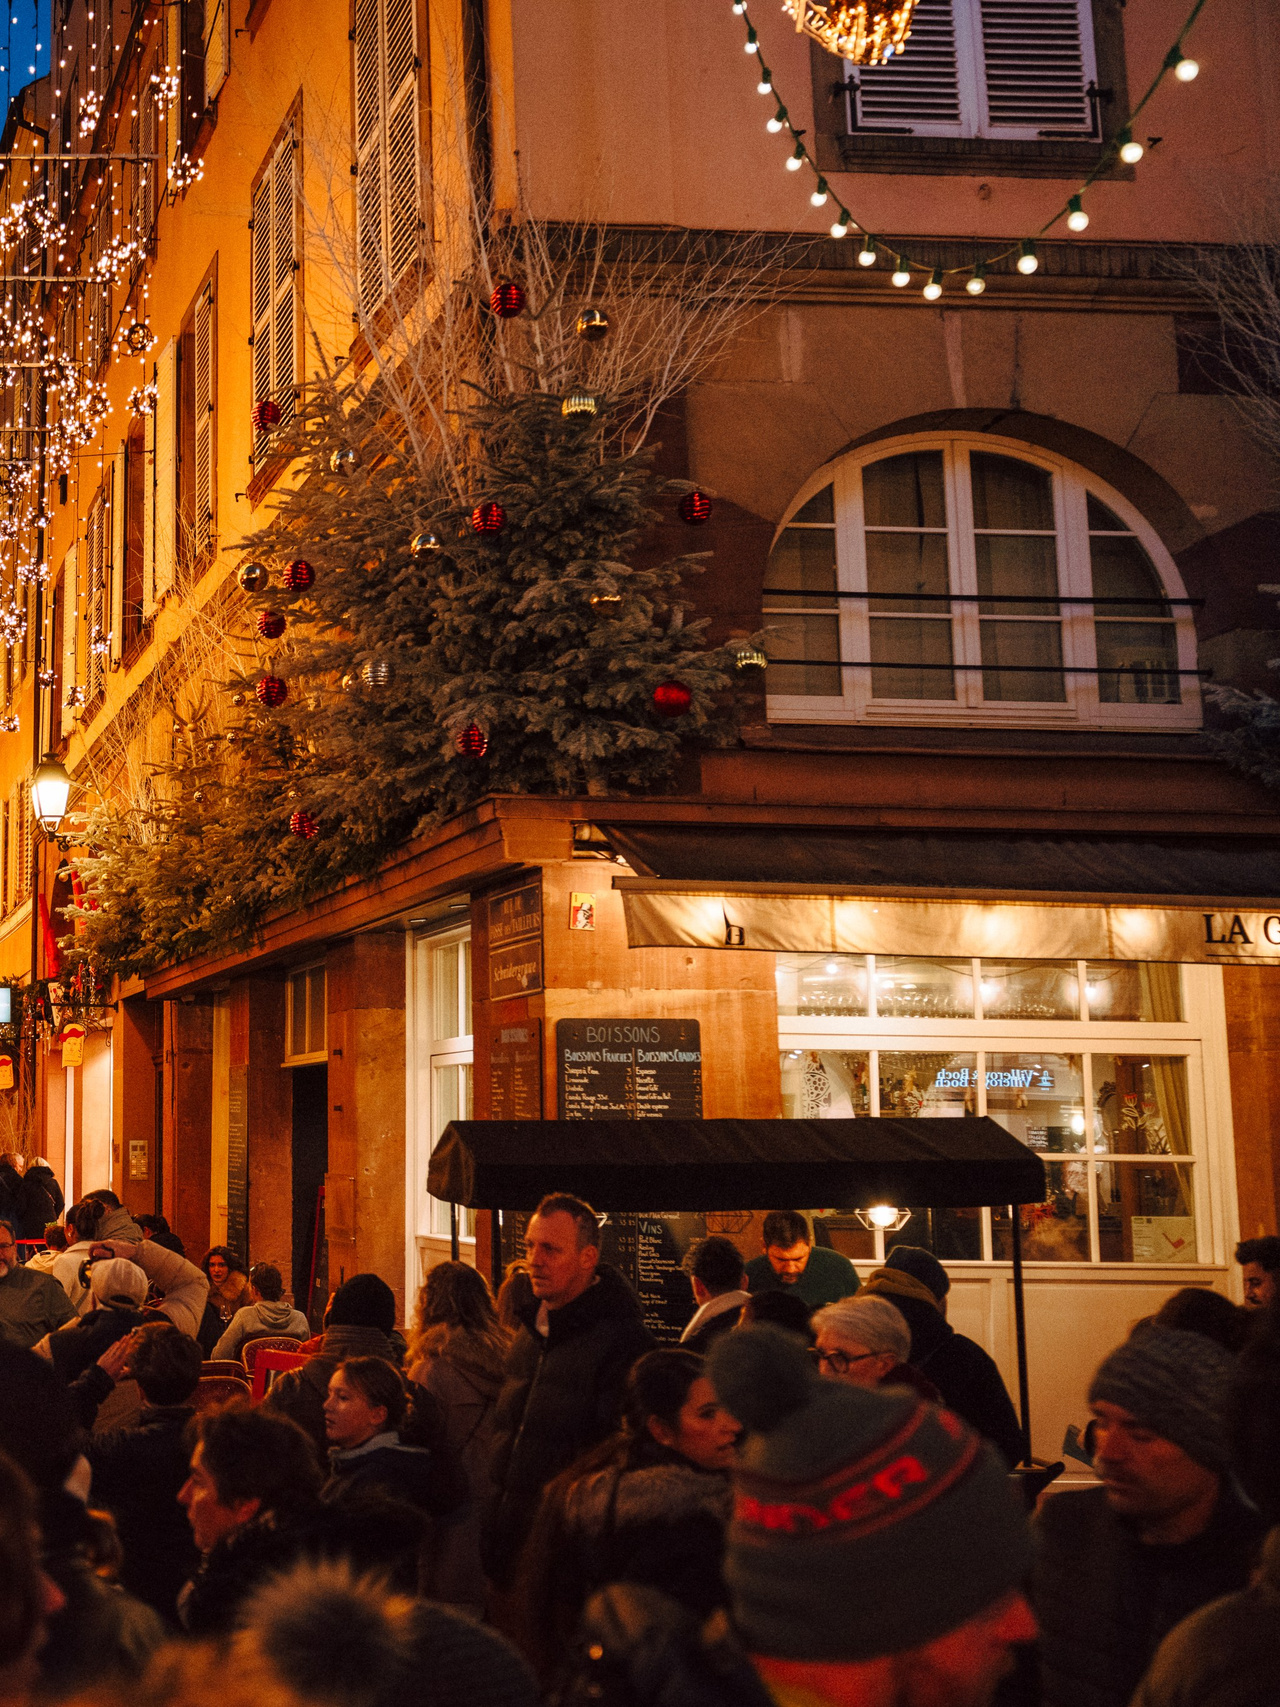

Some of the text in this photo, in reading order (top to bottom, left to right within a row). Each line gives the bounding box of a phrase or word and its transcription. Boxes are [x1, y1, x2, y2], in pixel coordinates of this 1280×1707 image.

[1202, 914, 1254, 944] LA
[586, 1026, 661, 1043] BOISSONS
[564, 1049, 601, 1062] BOISSONS
[637, 1049, 674, 1063] BOISSONS
[639, 1221, 663, 1235] VINS
